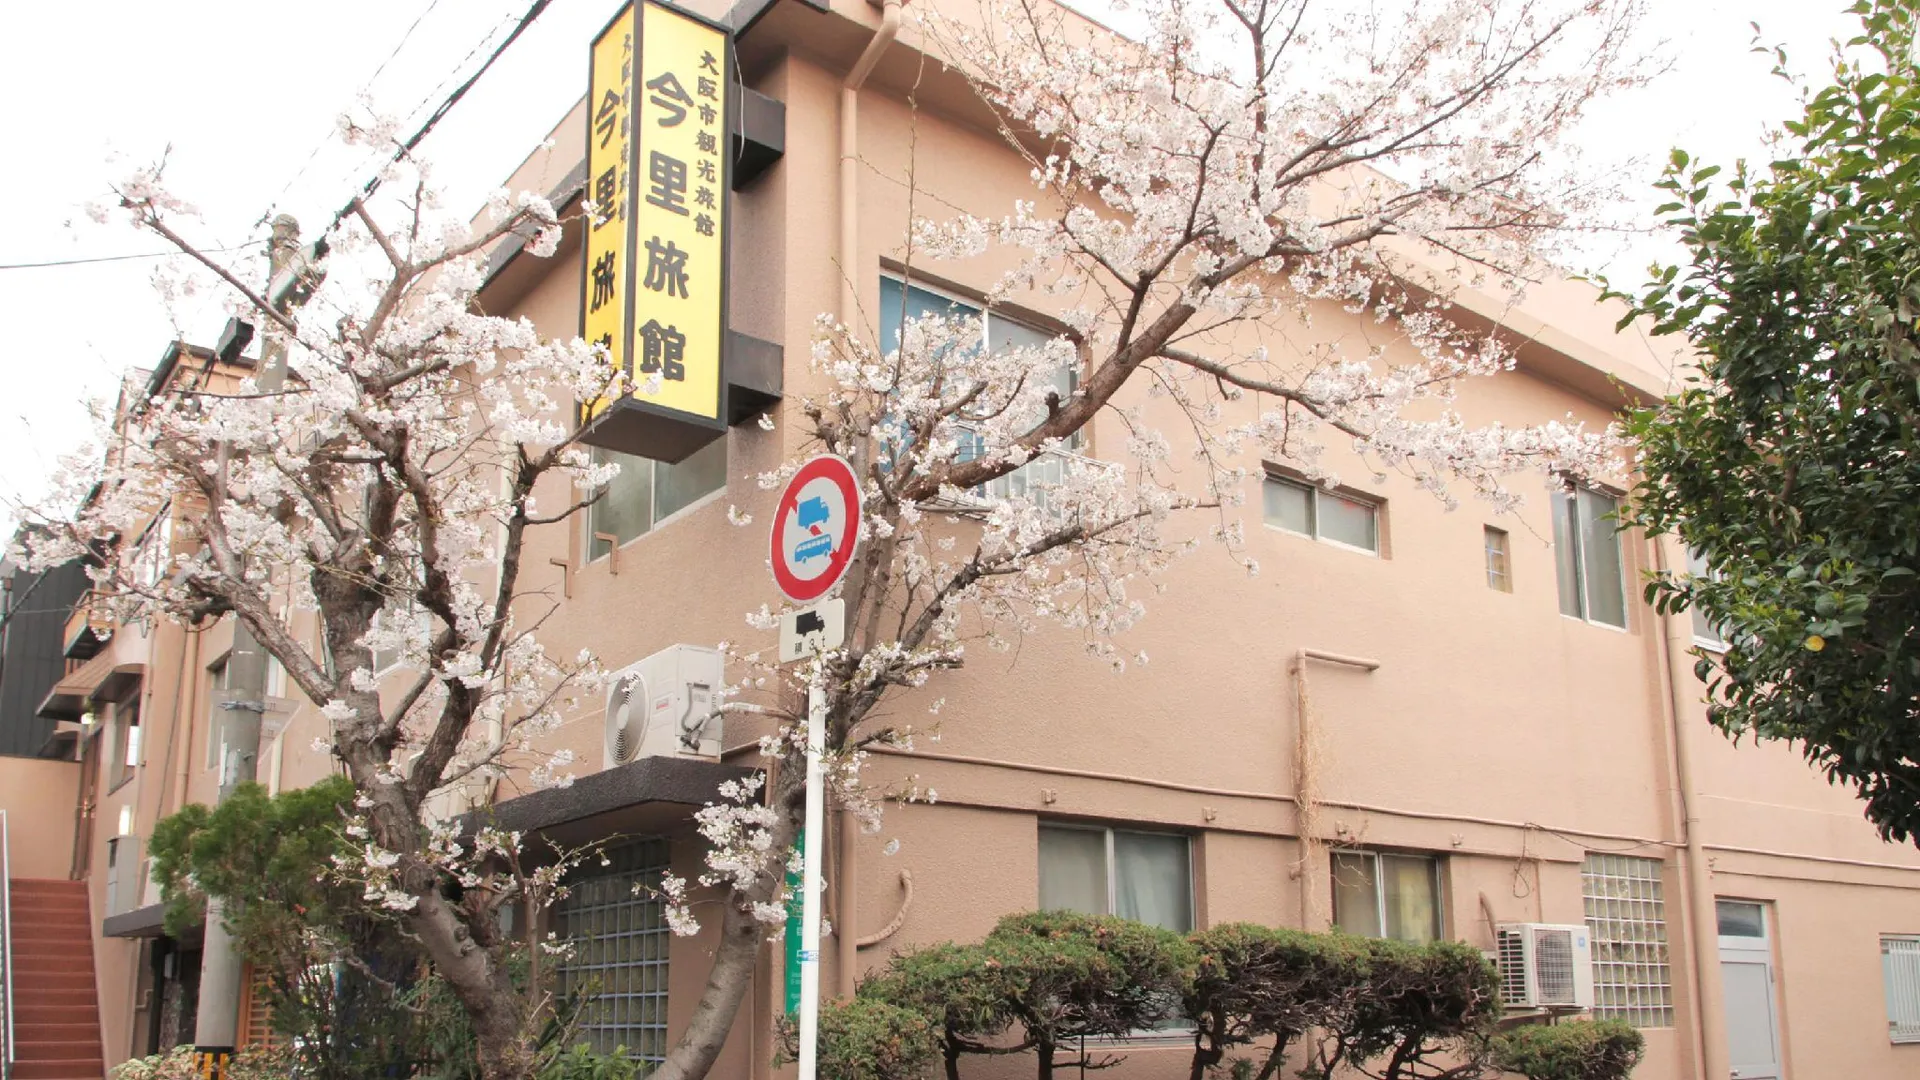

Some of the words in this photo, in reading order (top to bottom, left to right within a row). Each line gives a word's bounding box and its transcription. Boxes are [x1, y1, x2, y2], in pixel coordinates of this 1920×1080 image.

[591, 89, 620, 366] 今里旅
[639, 72, 694, 382] 今里旅館
[694, 50, 720, 237] 大阪市観光旅館
